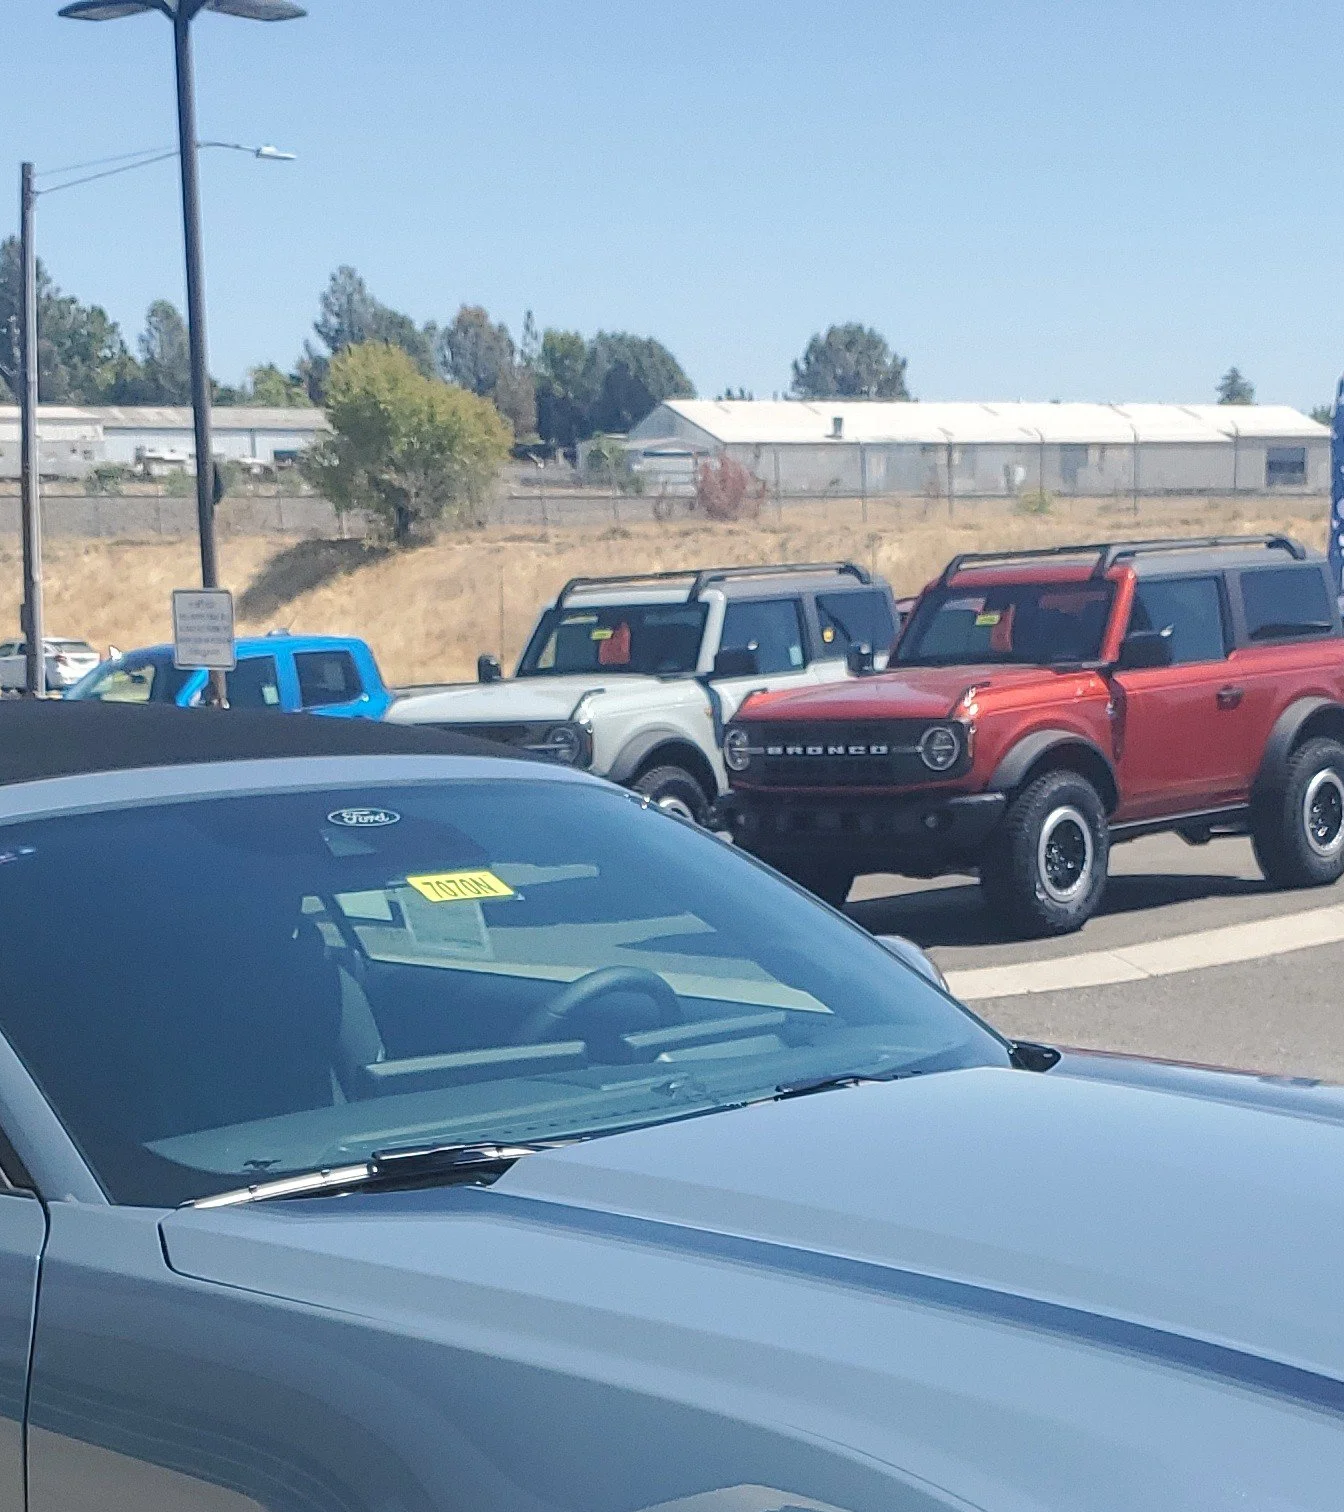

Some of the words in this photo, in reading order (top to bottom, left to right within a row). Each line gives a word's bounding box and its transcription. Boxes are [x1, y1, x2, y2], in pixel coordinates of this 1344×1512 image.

[766, 745, 889, 755] BRONCO
[341, 811, 390, 824] Ford
[421, 877, 499, 898] 7070N
